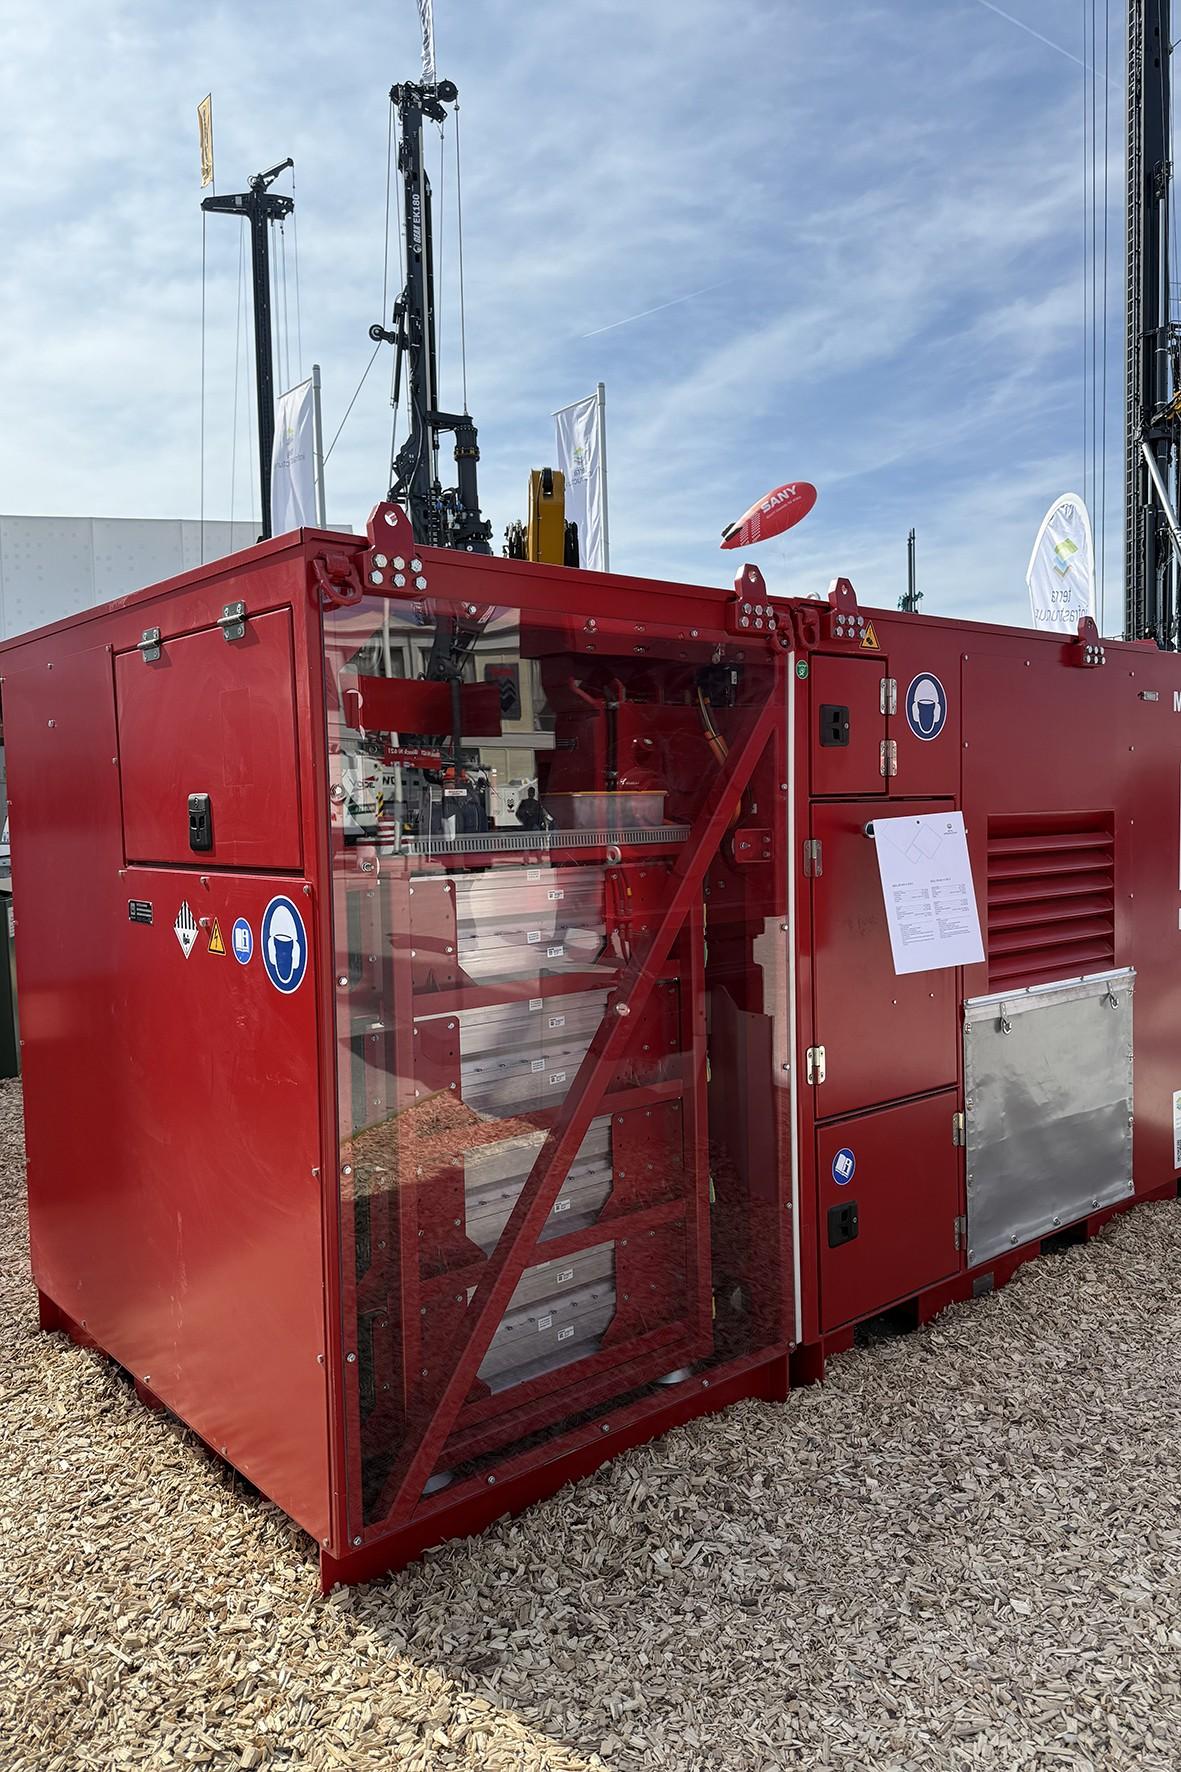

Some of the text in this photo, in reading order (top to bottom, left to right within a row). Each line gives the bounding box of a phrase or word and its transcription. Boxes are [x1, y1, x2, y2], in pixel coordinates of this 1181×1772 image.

[412, 193, 421, 243] GEAX EK180
[760, 485, 797, 514] SANY
